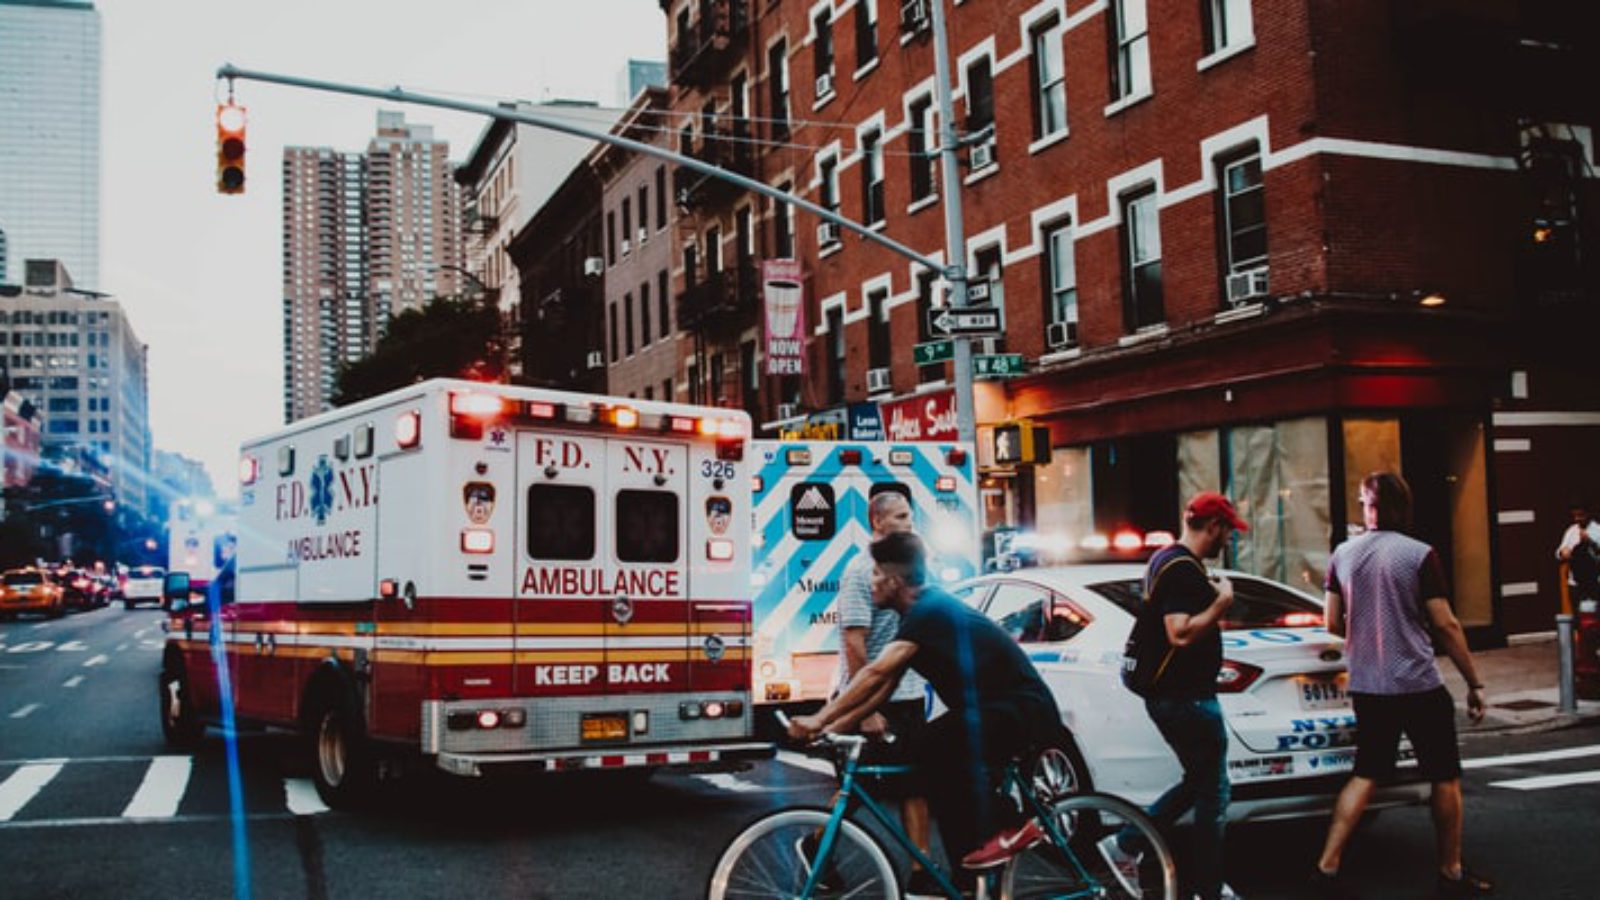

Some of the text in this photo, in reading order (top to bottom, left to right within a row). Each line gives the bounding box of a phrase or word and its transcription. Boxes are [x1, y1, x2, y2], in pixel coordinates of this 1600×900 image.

[969, 315, 993, 326] WAY
[769, 340, 800, 356] NOW
[924, 345, 935, 361] 9
[769, 358, 802, 375] OPEN
[978, 359, 989, 373] W
[991, 357, 1010, 374] 48
[535, 438, 590, 470] F.D.
[701, 459, 735, 480] 326
[286, 530, 361, 562] AMBULANCE
[521, 566, 679, 597] AMBULANCE
[534, 662, 671, 686] KEEP BACK
